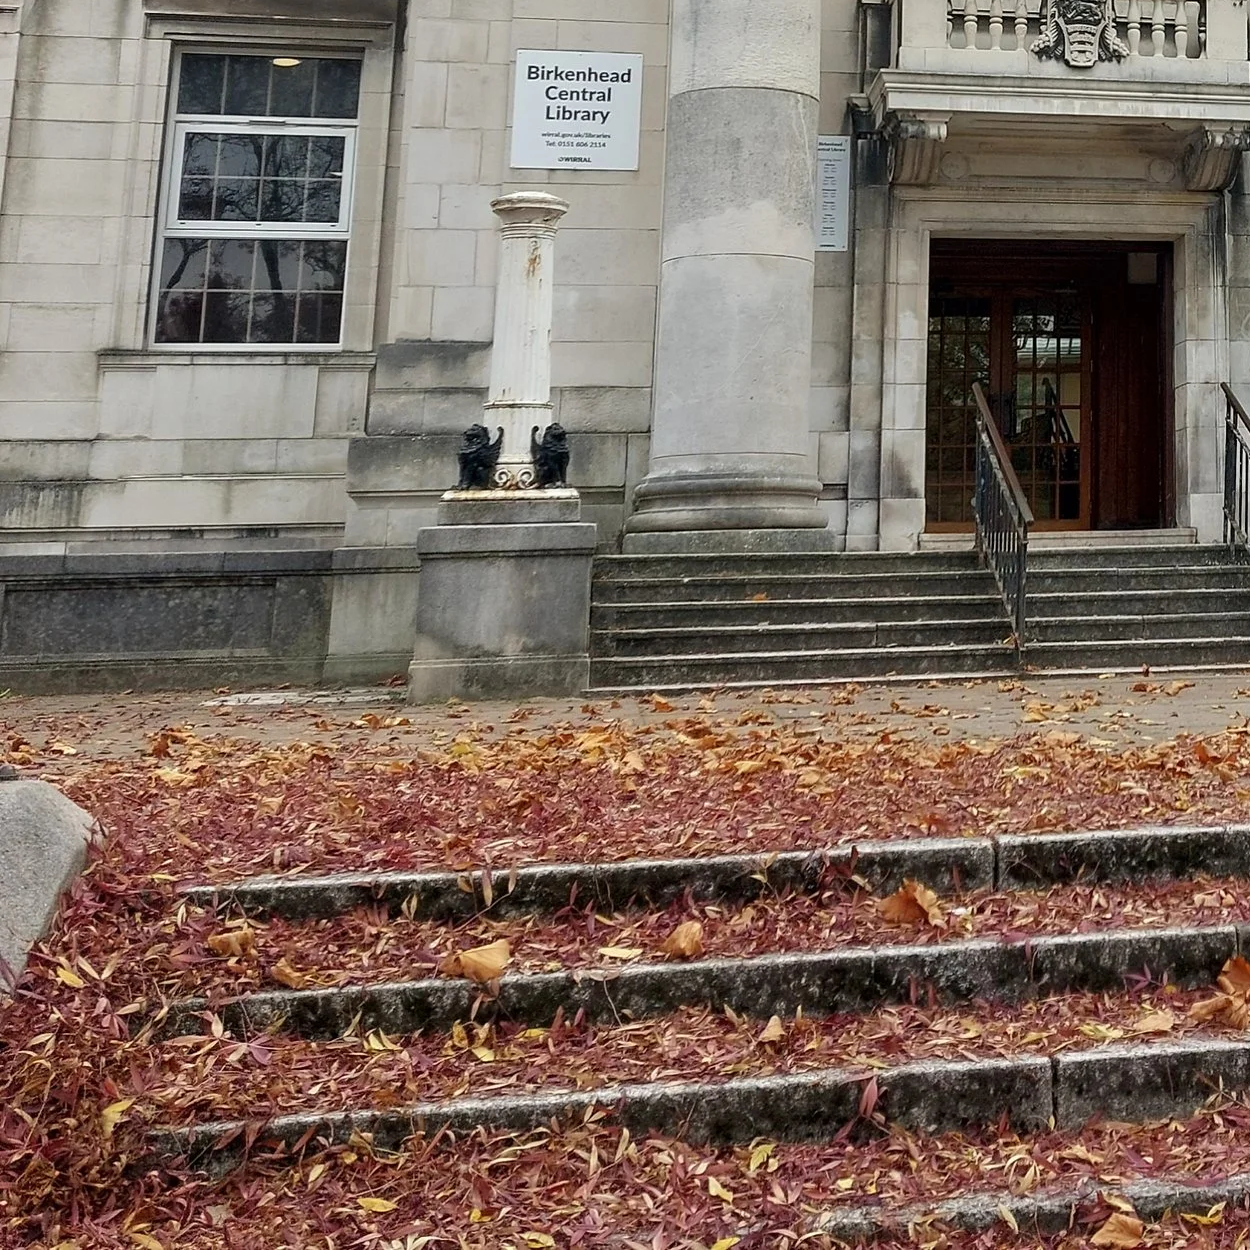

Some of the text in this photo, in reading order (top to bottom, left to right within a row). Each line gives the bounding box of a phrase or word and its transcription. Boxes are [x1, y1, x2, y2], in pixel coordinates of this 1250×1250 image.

[527, 64, 632, 83] Birkenhead
[545, 85, 612, 102] Central
[545, 105, 611, 125] Library
